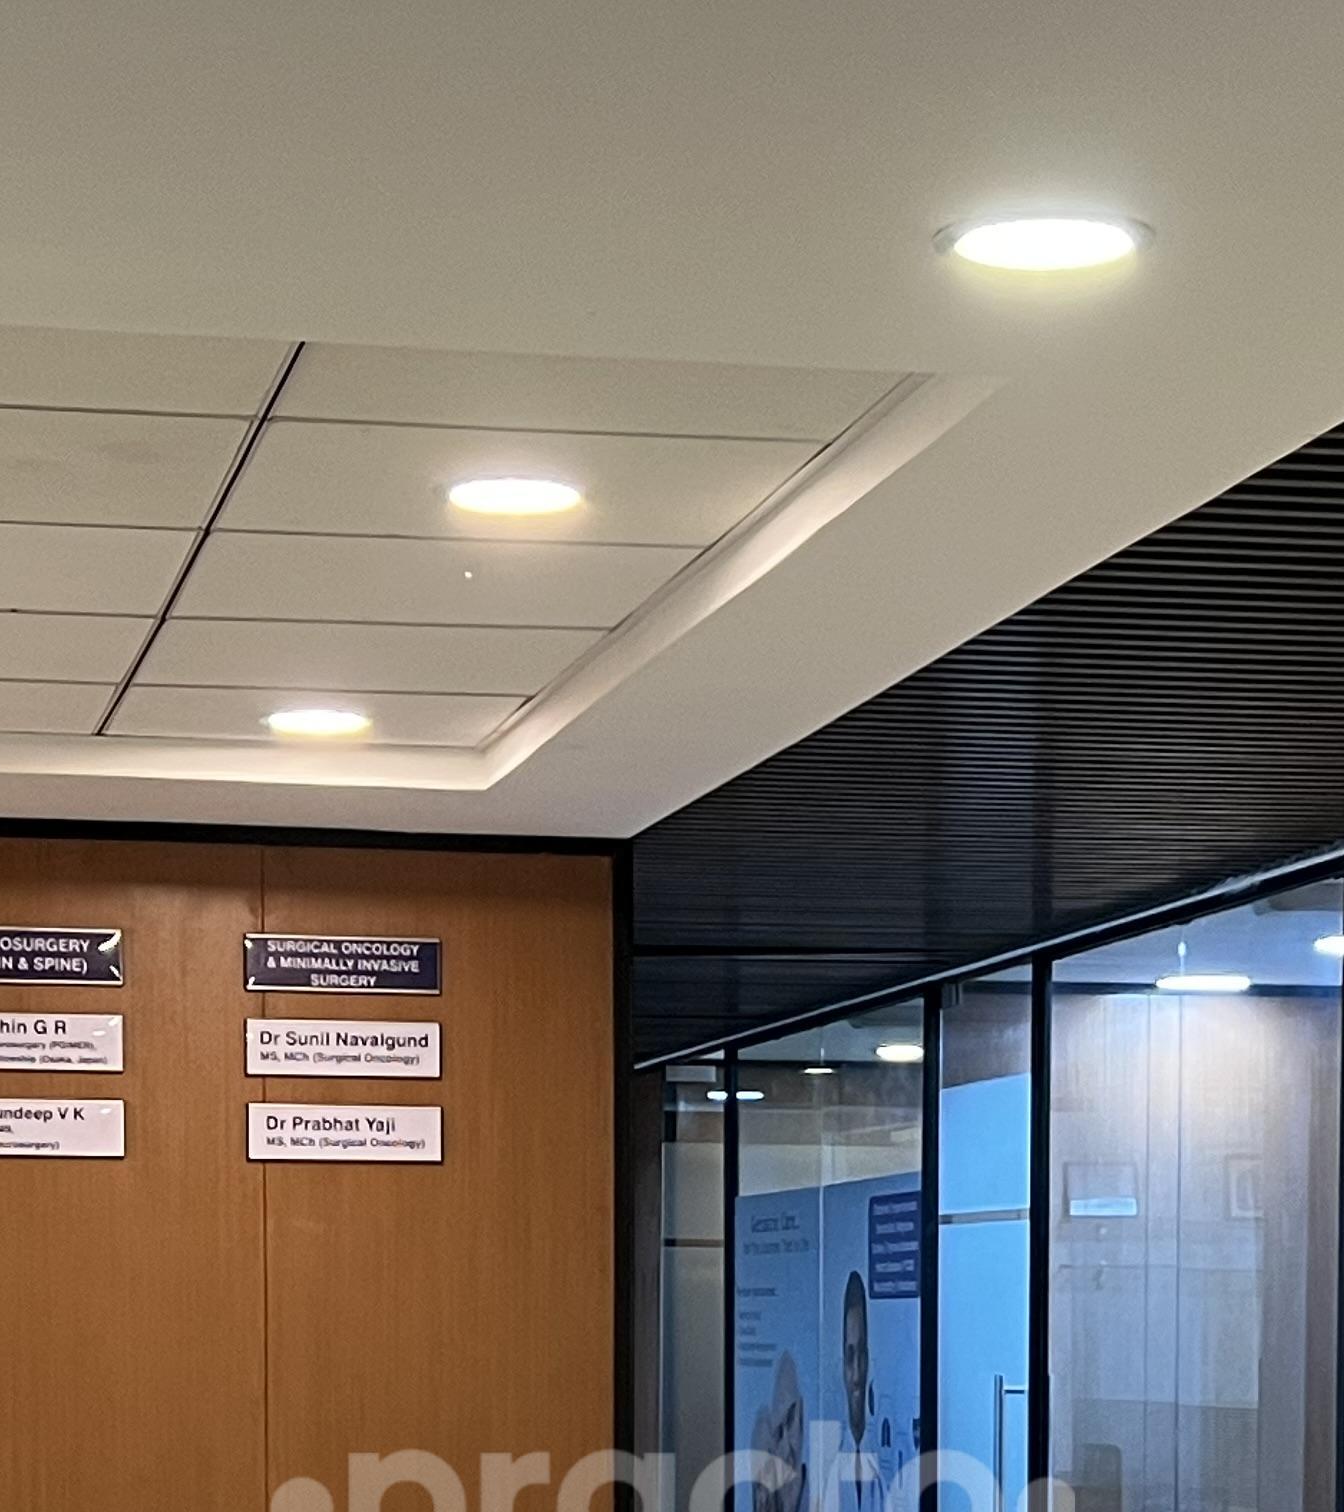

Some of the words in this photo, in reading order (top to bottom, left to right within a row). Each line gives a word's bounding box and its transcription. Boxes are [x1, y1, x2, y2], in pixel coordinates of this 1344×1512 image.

[267, 940, 338, 954] SURGICAL
[342, 942, 420, 957] ONCOLOGY
[18, 957, 28, 970] &
[34, 957, 87, 974] SPINE)
[267, 957, 276, 968] &
[280, 957, 354, 971] MINIMALLY
[358, 960, 419, 972] INVASIVE
[311, 974, 377, 987] SURGERY
[34, 1020, 47, 1034] G
[55, 1021, 67, 1034] R
[260, 1031, 280, 1045] Dr
[286, 1031, 330, 1046] Sunil
[336, 1032, 429, 1050] Navalgund
[58, 1108, 69, 1120] V
[73, 1108, 84, 1120] K
[266, 1116, 286, 1130] Dr
[293, 1117, 360, 1132] Prabhat
[365, 1118, 395, 1135] Yaji
